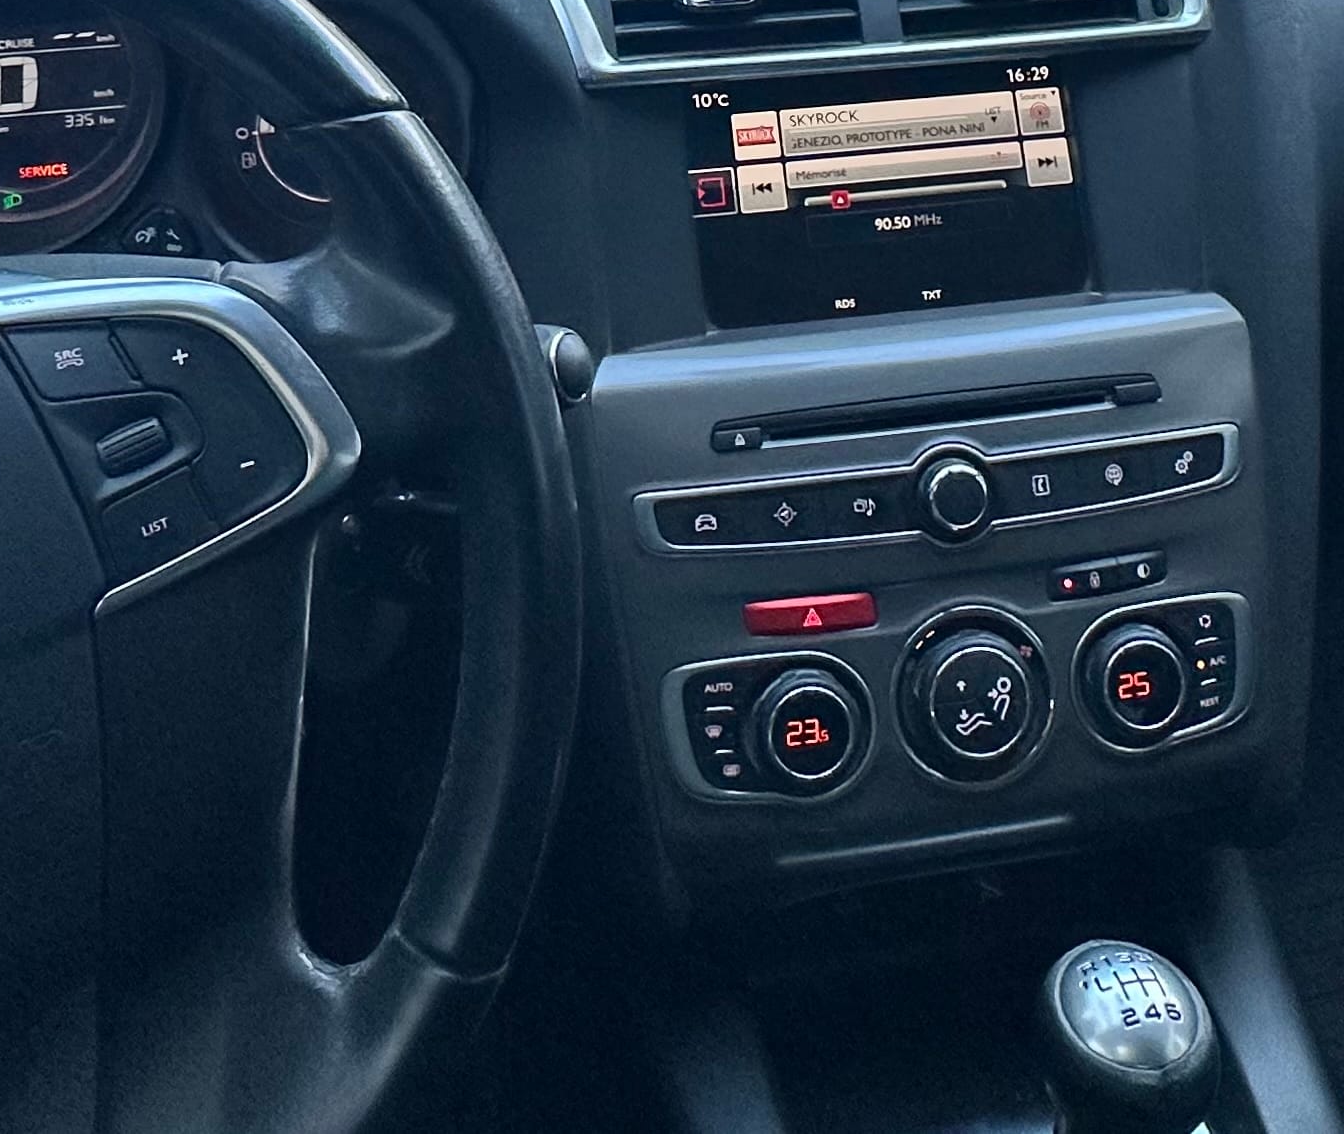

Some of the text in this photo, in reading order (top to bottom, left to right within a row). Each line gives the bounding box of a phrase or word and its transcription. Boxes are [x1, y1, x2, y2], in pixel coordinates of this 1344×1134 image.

[1006, 66, 1049, 83] 16:29
[692, 92, 730, 109] 10°C
[789, 110, 860, 128] SKYROCK
[846, 128, 914, 144] PROTOTYPE
[922, 125, 957, 137] PONA
[19, 162, 69, 179] SERVICE
[874, 213, 943, 232] 90.50 MHz
[921, 289, 942, 301] TXT
[834, 298, 856, 310] RDS
[54, 347, 83, 362] SRC
[141, 517, 169, 538] LIST
[1209, 655, 1227, 667] A/C
[704, 682, 734, 694] AUTO
[1118, 671, 1150, 700] 25
[1121, 1007, 1141, 1030] 2
[1144, 1004, 1163, 1021] 4
